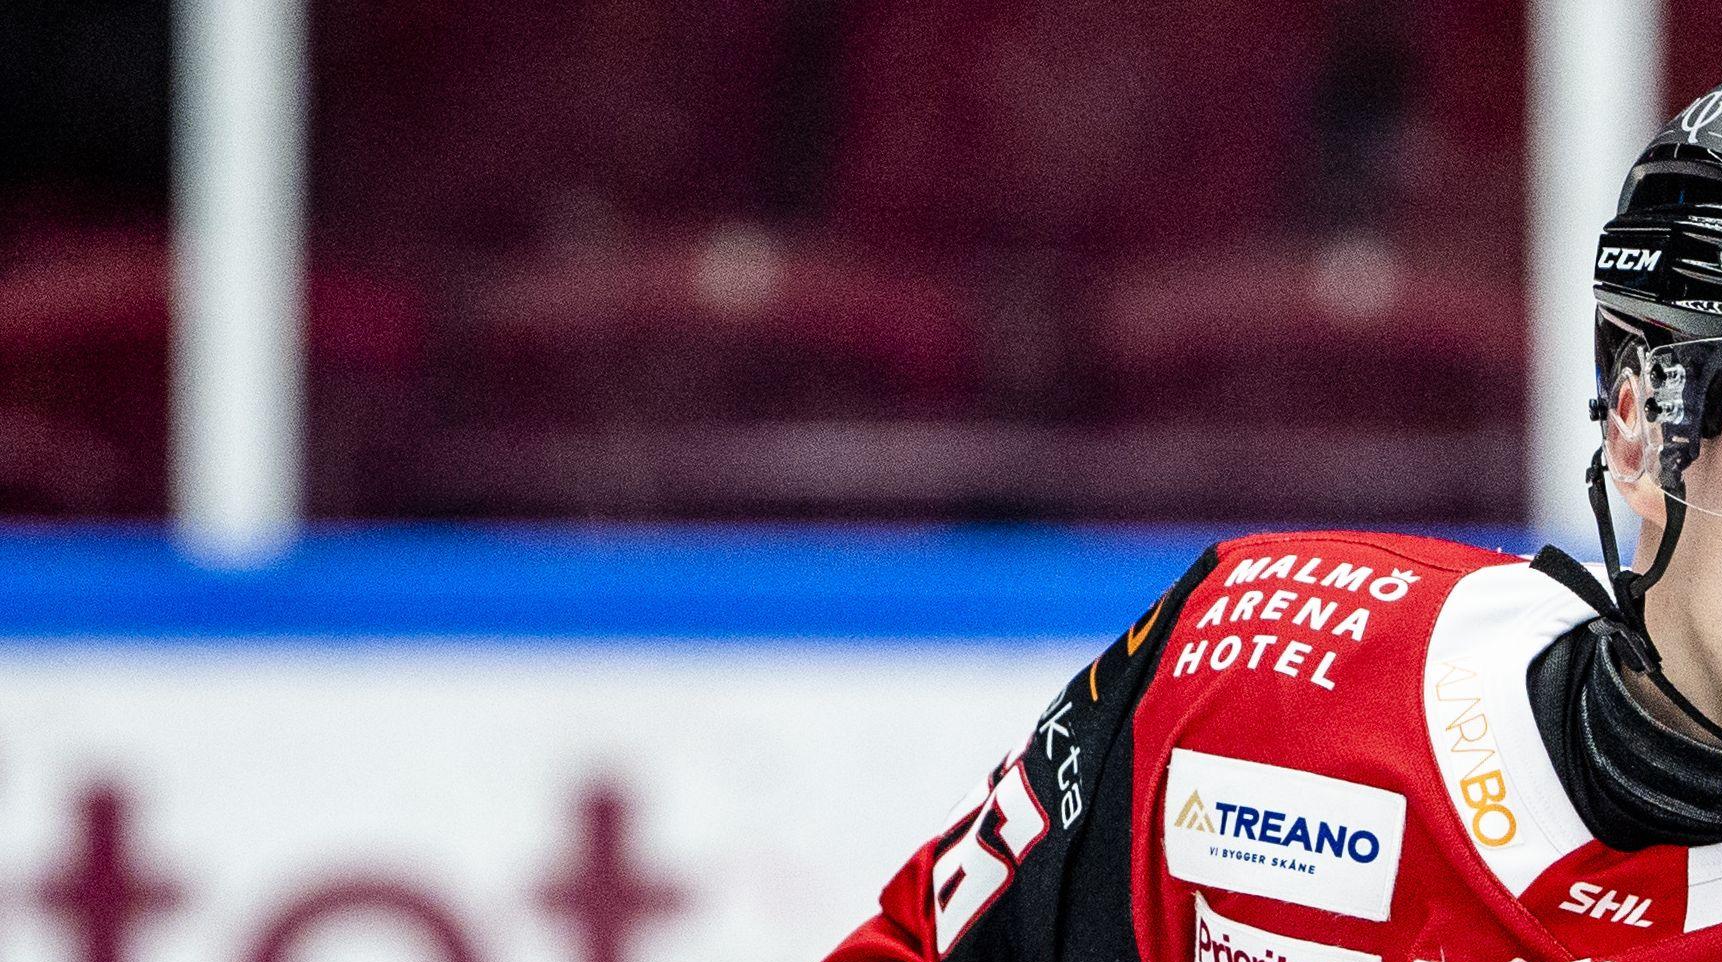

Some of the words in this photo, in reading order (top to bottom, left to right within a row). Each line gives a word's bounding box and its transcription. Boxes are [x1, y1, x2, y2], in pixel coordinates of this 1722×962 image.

[1597, 246, 1662, 271] CCM
[1224, 554, 1422, 602] MALMÖ
[1197, 589, 1371, 642] ARENA
[1173, 635, 1342, 690] HOTEL
[1215, 801, 1380, 864] TREANO
[1208, 846, 1218, 857] VI
[1221, 848, 1266, 865] BYGGER
[1271, 857, 1317, 875] SKÅNE
[1557, 881, 1654, 928] SHL
